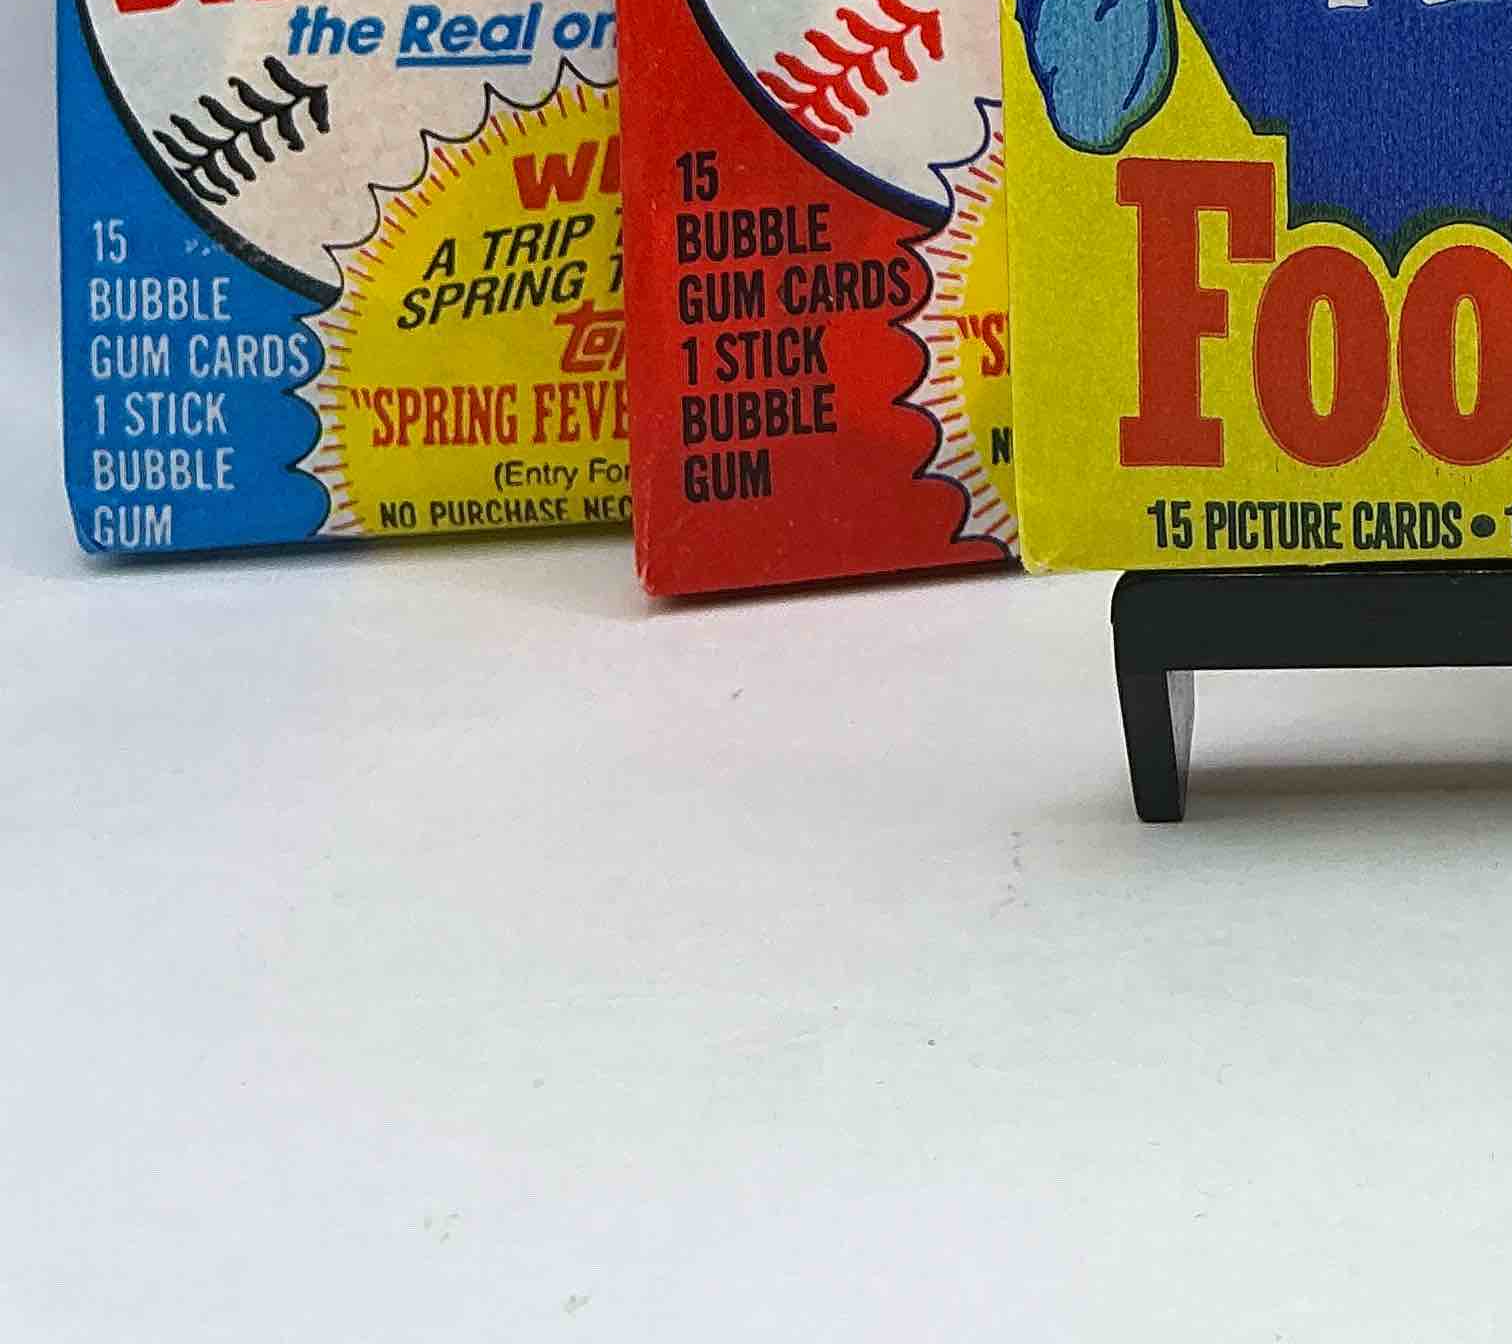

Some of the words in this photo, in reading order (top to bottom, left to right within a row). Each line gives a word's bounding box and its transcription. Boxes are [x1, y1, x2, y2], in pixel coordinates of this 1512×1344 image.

[288, 3, 384, 54] the
[399, 2, 544, 53] Real
[676, 150, 718, 203] 15
[93, 219, 128, 264] 15
[423, 238, 457, 281] A
[483, 214, 596, 272] TRIP
[676, 204, 831, 265] BUBBLE
[90, 277, 231, 322] BUBBLE
[397, 262, 587, 329] SPRING
[678, 270, 766, 327] GUM
[784, 257, 913, 314] CARDS
[90, 335, 171, 380] GUM
[188, 333, 309, 380] CARDS
[681, 335, 697, 385] 1
[715, 326, 828, 384] STICK
[95, 393, 106, 436] 1
[125, 392, 226, 436] STICK
[681, 383, 837, 446] BUBBLE
[92, 448, 235, 493] BUBBLE
[493, 460, 579, 494] (Entry
[683, 449, 772, 504] GUM
[92, 505, 172, 548] GUM
[380, 501, 417, 529] NO
[430, 500, 569, 528] PURCHASE
[1148, 498, 1193, 551] 15
[1205, 499, 1344, 551] PICTURE
[1353, 499, 1462, 551] CARDS
